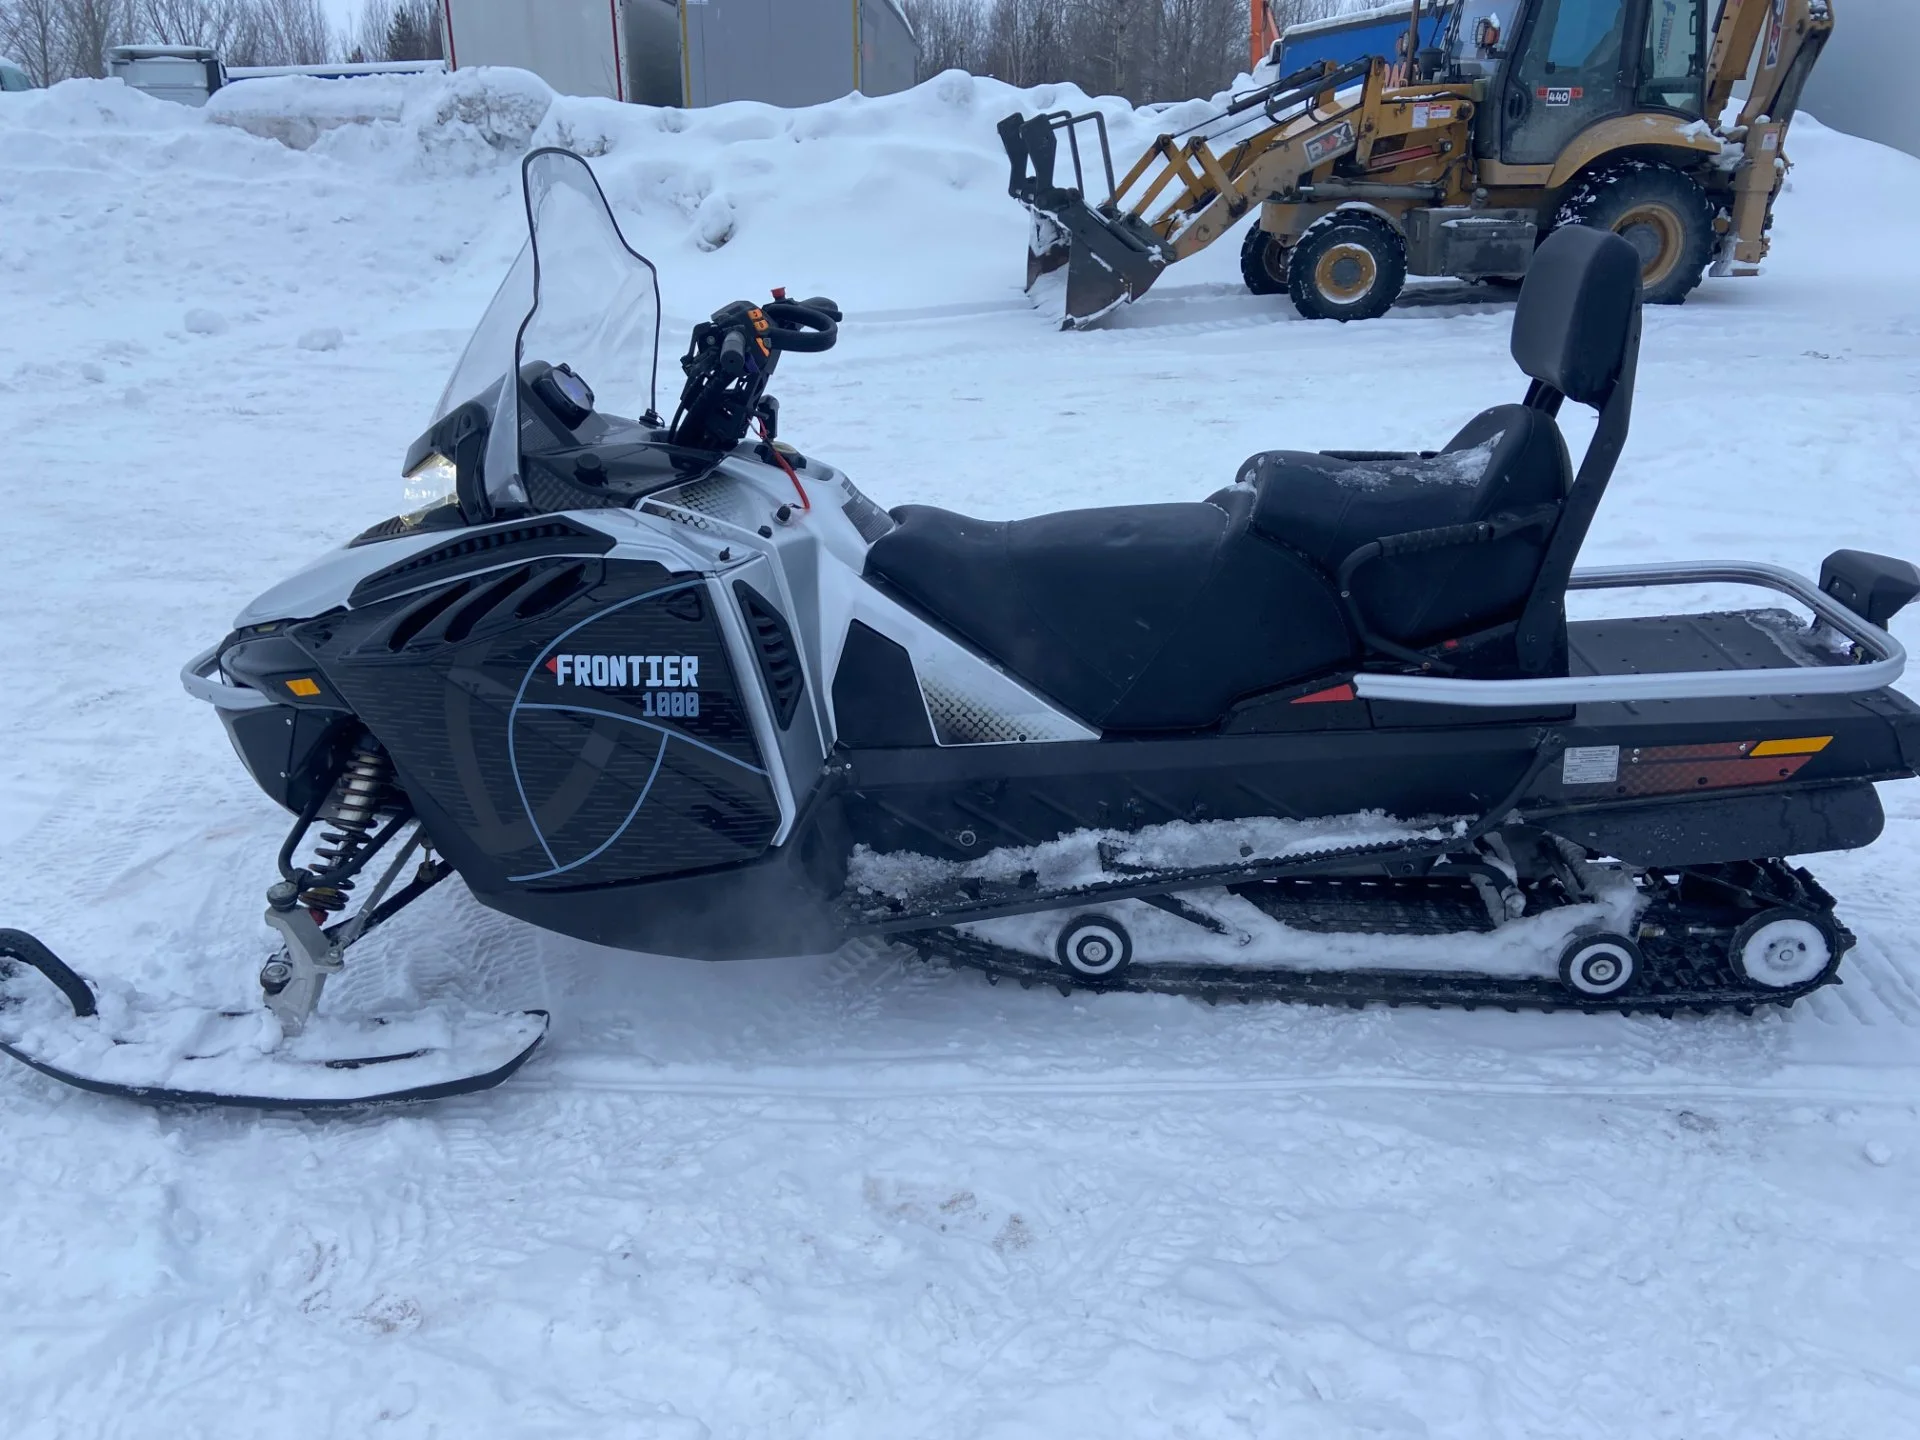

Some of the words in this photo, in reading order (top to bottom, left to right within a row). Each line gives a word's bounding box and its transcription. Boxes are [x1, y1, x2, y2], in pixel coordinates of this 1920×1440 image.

[1549, 92, 1568, 102] 440
[556, 654, 698, 687] FRONTIER
[642, 691, 699, 717] 1000
